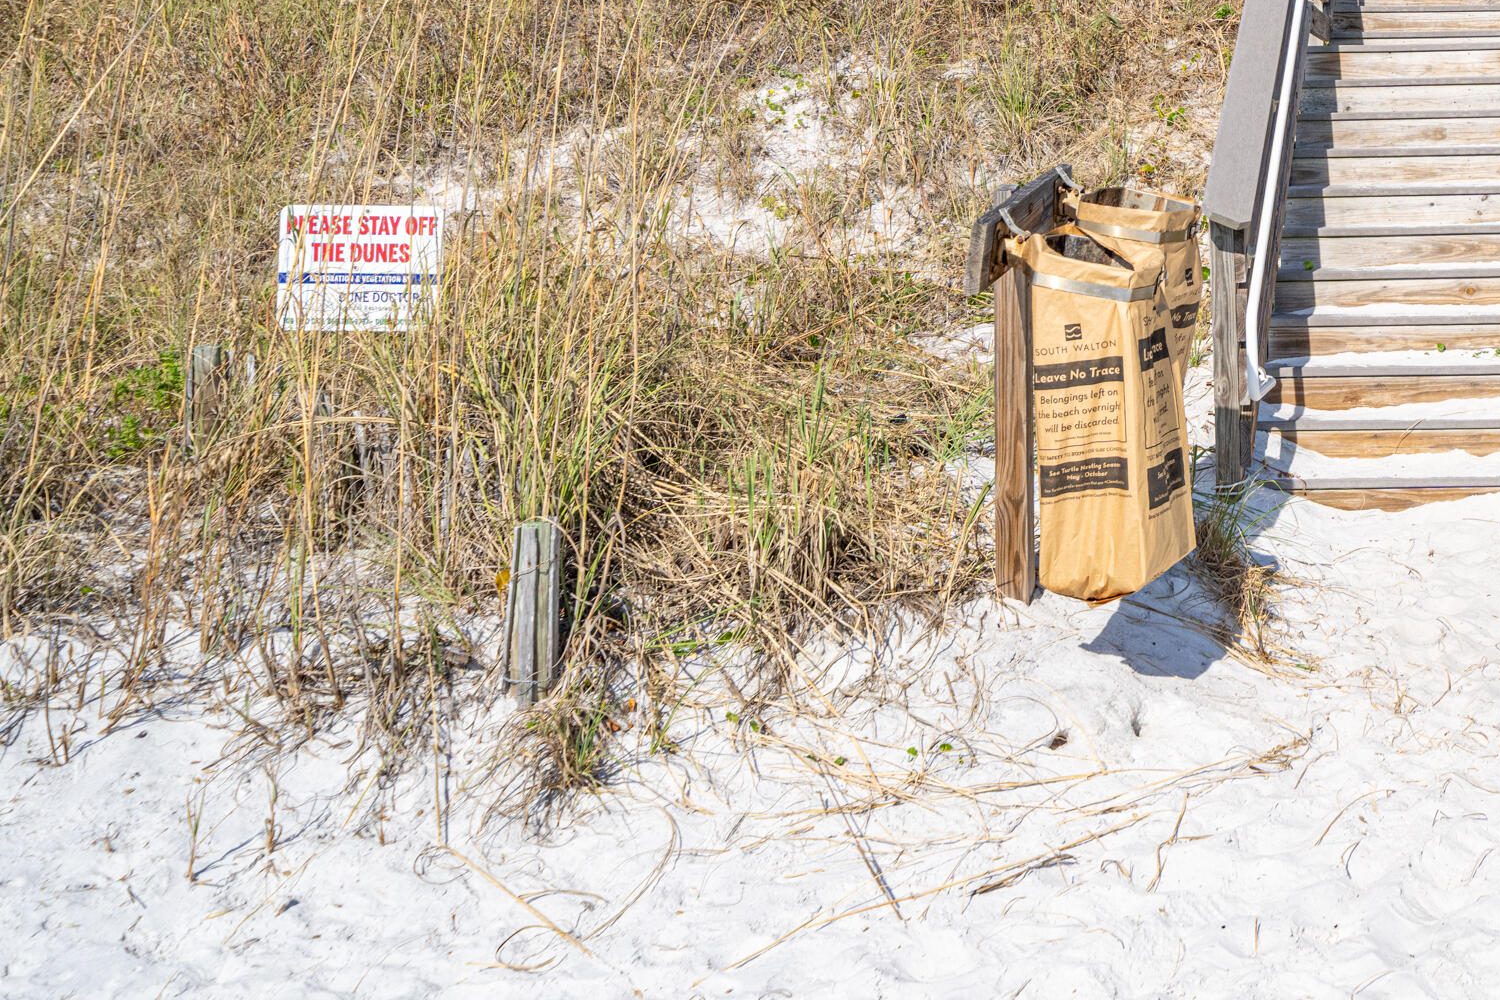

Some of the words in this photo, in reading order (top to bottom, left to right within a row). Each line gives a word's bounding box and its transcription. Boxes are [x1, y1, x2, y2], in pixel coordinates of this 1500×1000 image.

[286, 215, 353, 235] PLEASE
[358, 216, 401, 235] STAY
[405, 216, 438, 236] OFF
[311, 242, 345, 262] THE
[350, 243, 411, 263] DUNES
[362, 275, 402, 283] VEGETATION
[372, 292, 426, 303] DOCTOR
[1035, 346, 1068, 357] SOUTH
[1073, 340, 1116, 352] WALTON
[1034, 372, 1067, 384] Leave
[1070, 368, 1087, 380] No
[1089, 366, 1121, 378] Trace
[1040, 393, 1088, 405] Belongings
[1090, 387, 1105, 400] left
[1038, 410, 1051, 419] the
[1052, 406, 1080, 419] beach
[1045, 424, 1059, 433] will
[1061, 423, 1072, 432] be
[1061, 466, 1079, 474] Turtle
